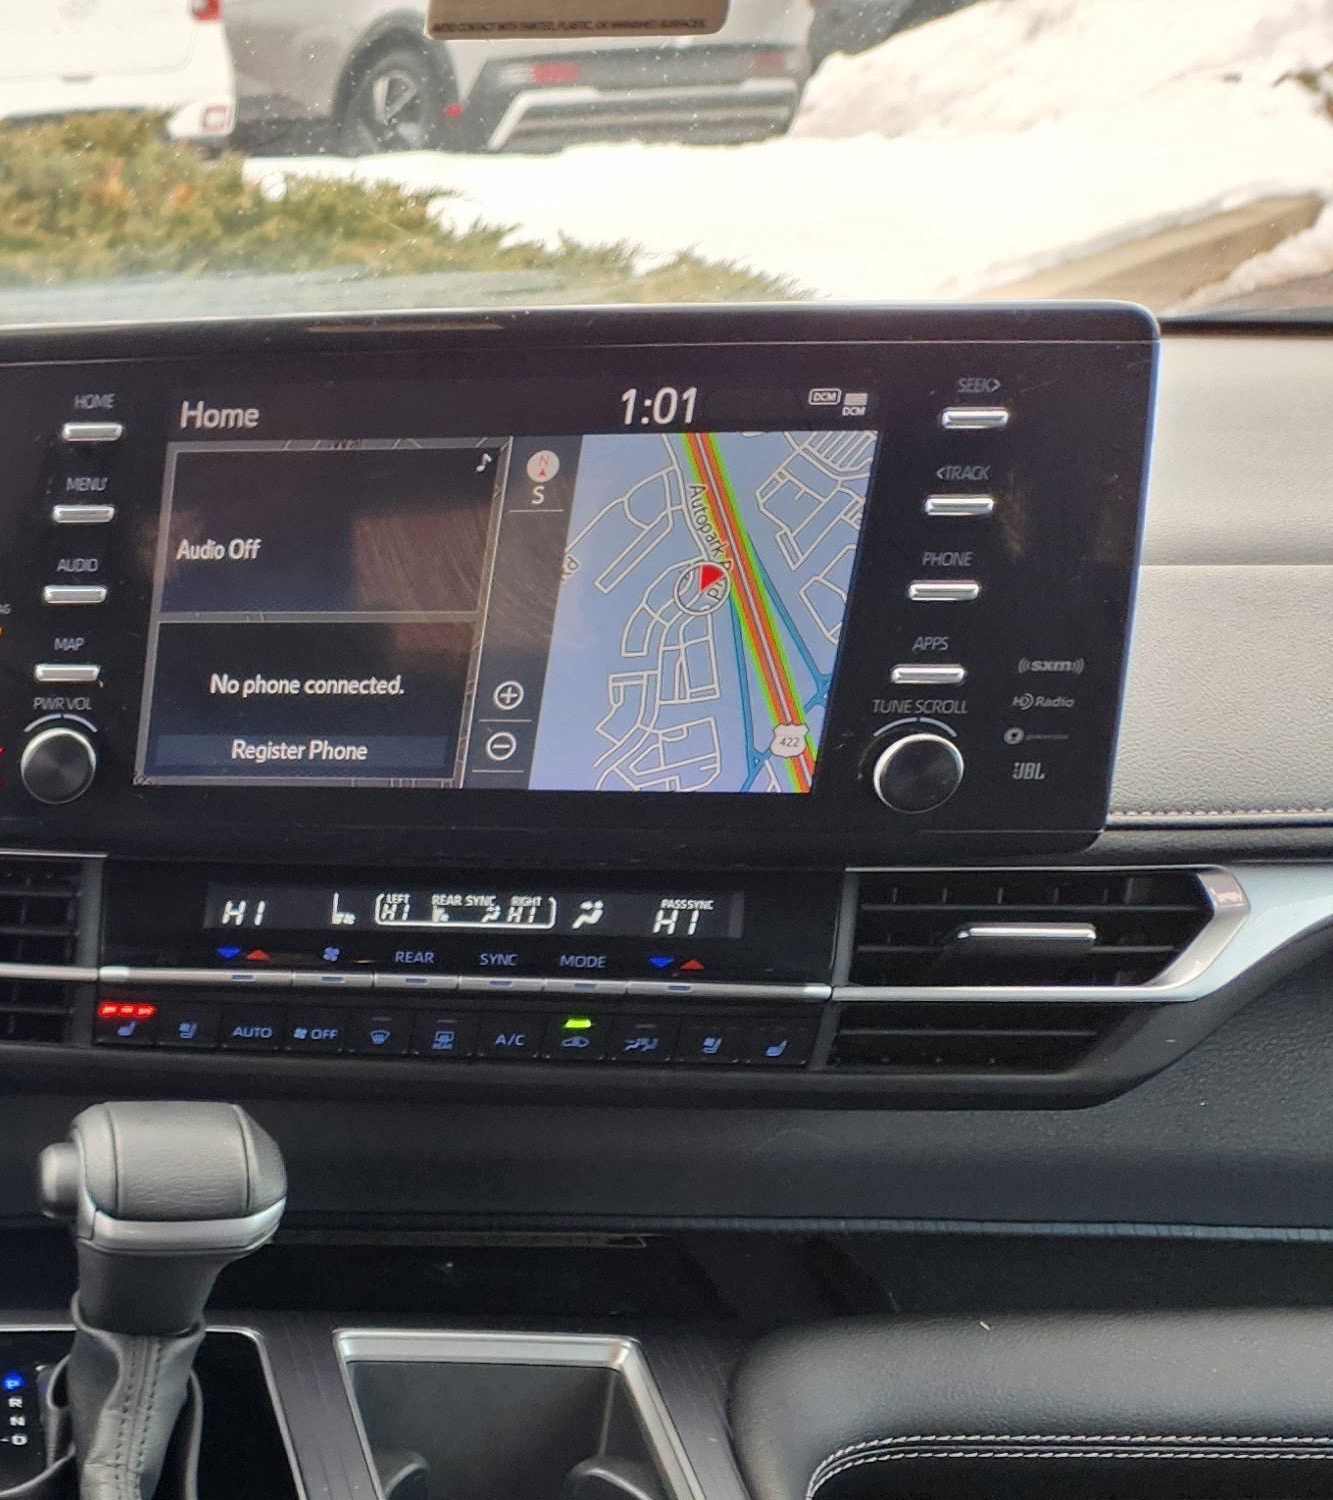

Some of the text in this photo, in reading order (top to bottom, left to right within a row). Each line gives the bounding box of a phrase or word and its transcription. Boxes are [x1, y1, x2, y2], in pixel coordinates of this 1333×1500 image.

[74, 393, 115, 410] HOME
[812, 391, 838, 402] DCM
[621, 386, 698, 425] 1:01
[841, 406, 867, 416] DCM
[180, 400, 260, 429] Home
[538, 454, 550, 466] N
[66, 477, 108, 492] MENU
[531, 485, 545, 505] S
[688, 484, 728, 558] Autopark
[175, 538, 263, 560] Audio Off
[56, 558, 99, 573] AUDIO
[922, 552, 974, 567] PHONE
[53, 637, 85, 651] MAP
[912, 636, 950, 651] APPS
[209, 673, 405, 698] No phone connected.
[34, 697, 93, 710] PWR VOL
[872, 699, 969, 714] TUNE SCROLL
[1035, 696, 1076, 708] Radio
[779, 736, 800, 748] 422
[231, 738, 369, 763] Register Phone
[1012, 762, 1046, 780] JBL
[222, 900, 266, 926] HI
[653, 909, 700, 935] HI
[395, 950, 435, 964] REAR
[478, 953, 518, 967] SYNC
[559, 954, 607, 969] MODE
[233, 1026, 273, 1039] AUTO
[310, 1029, 338, 1040] OFF
[494, 1033, 526, 1046] A/C
[8, 1396, 23, 1408] R
[9, 1415, 26, 1426] N
[11, 1434, 28, 1446] D
